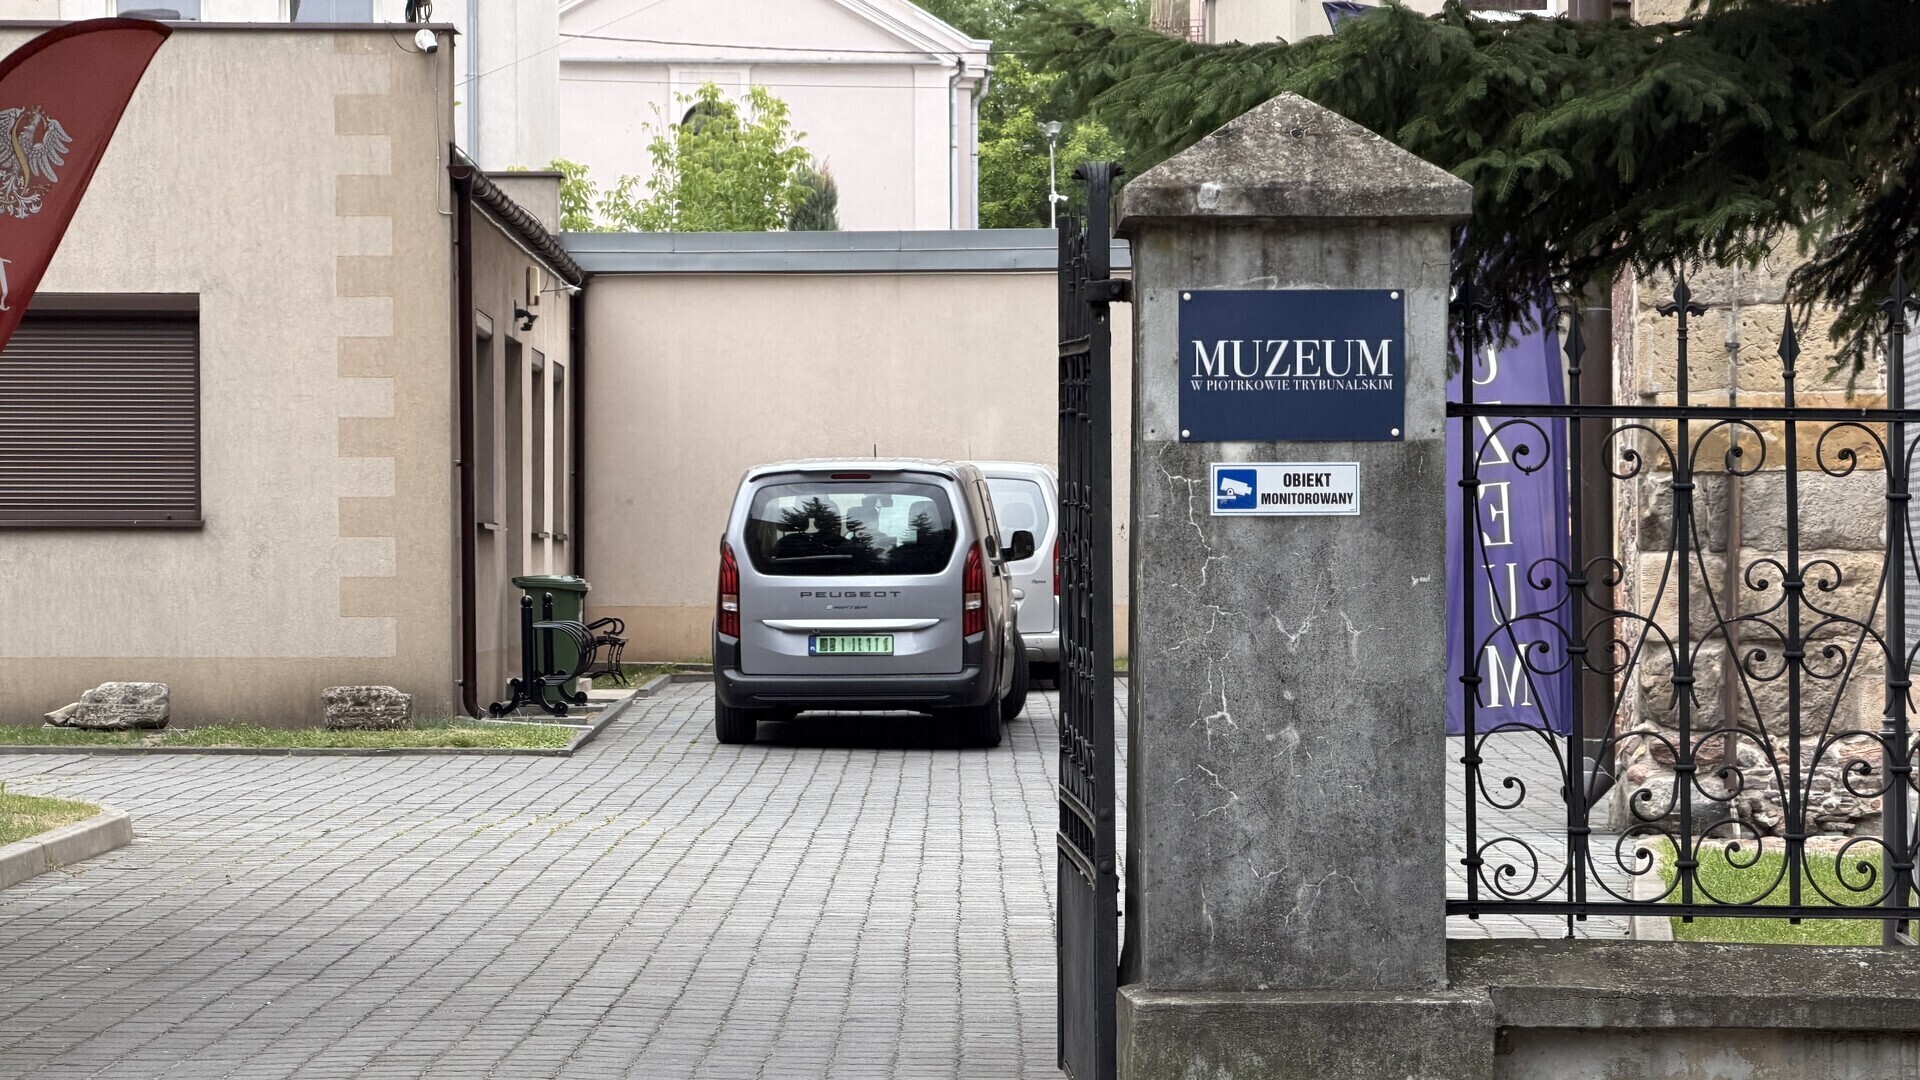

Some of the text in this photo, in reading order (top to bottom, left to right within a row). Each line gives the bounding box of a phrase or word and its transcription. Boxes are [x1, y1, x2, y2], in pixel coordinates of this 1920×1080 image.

[1191, 339, 1393, 377] MUZEUM
[1191, 379, 1394, 391] W PIOTRKOWIE TRYBUNALSKIM
[1283, 473, 1332, 488] OBIEKT
[1260, 492, 1354, 505] MONITOROWANY
